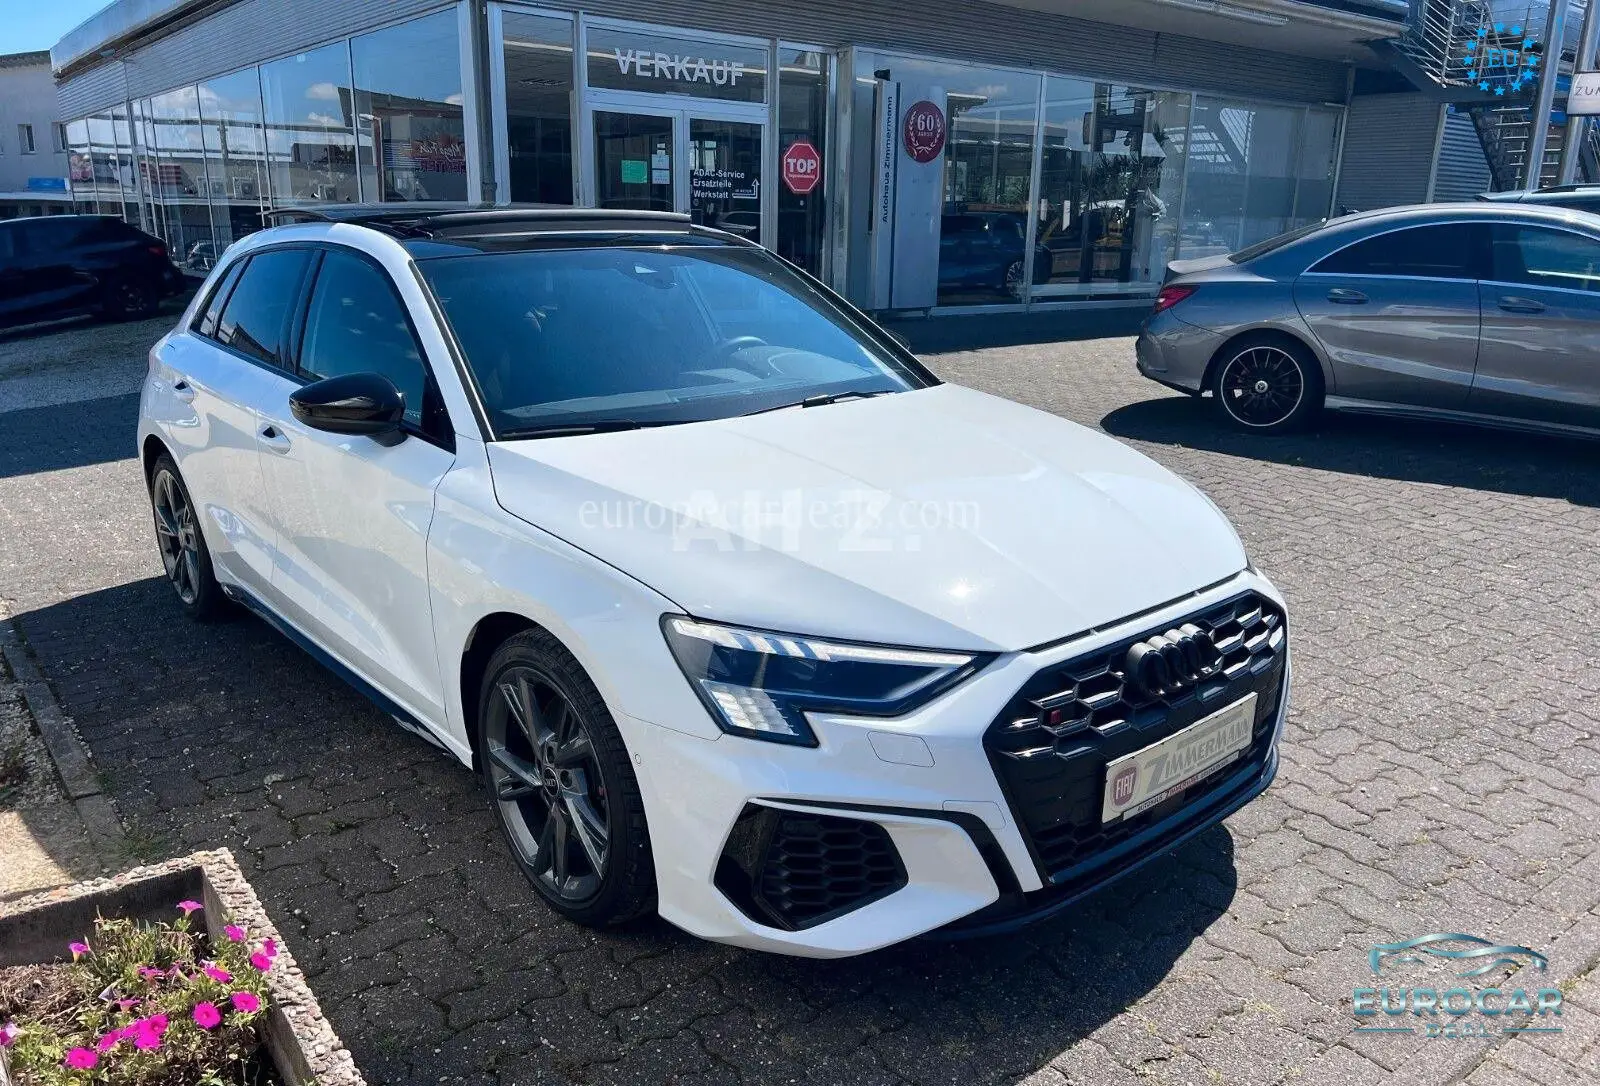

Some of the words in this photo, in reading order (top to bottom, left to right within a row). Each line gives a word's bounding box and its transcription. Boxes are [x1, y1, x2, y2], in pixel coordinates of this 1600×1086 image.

[615, 47, 744, 86] VERKAUF
[917, 113, 934, 131] 60
[885, 96, 893, 169] Zimmermann
[693, 168, 745, 179] ADAC-Service
[787, 158, 817, 173] TOP
[693, 178, 732, 188] Ersatzteile
[694, 189, 729, 199] Werkstatt
[882, 171, 890, 222] Autohaus
[1115, 772, 1135, 800] FIAT
